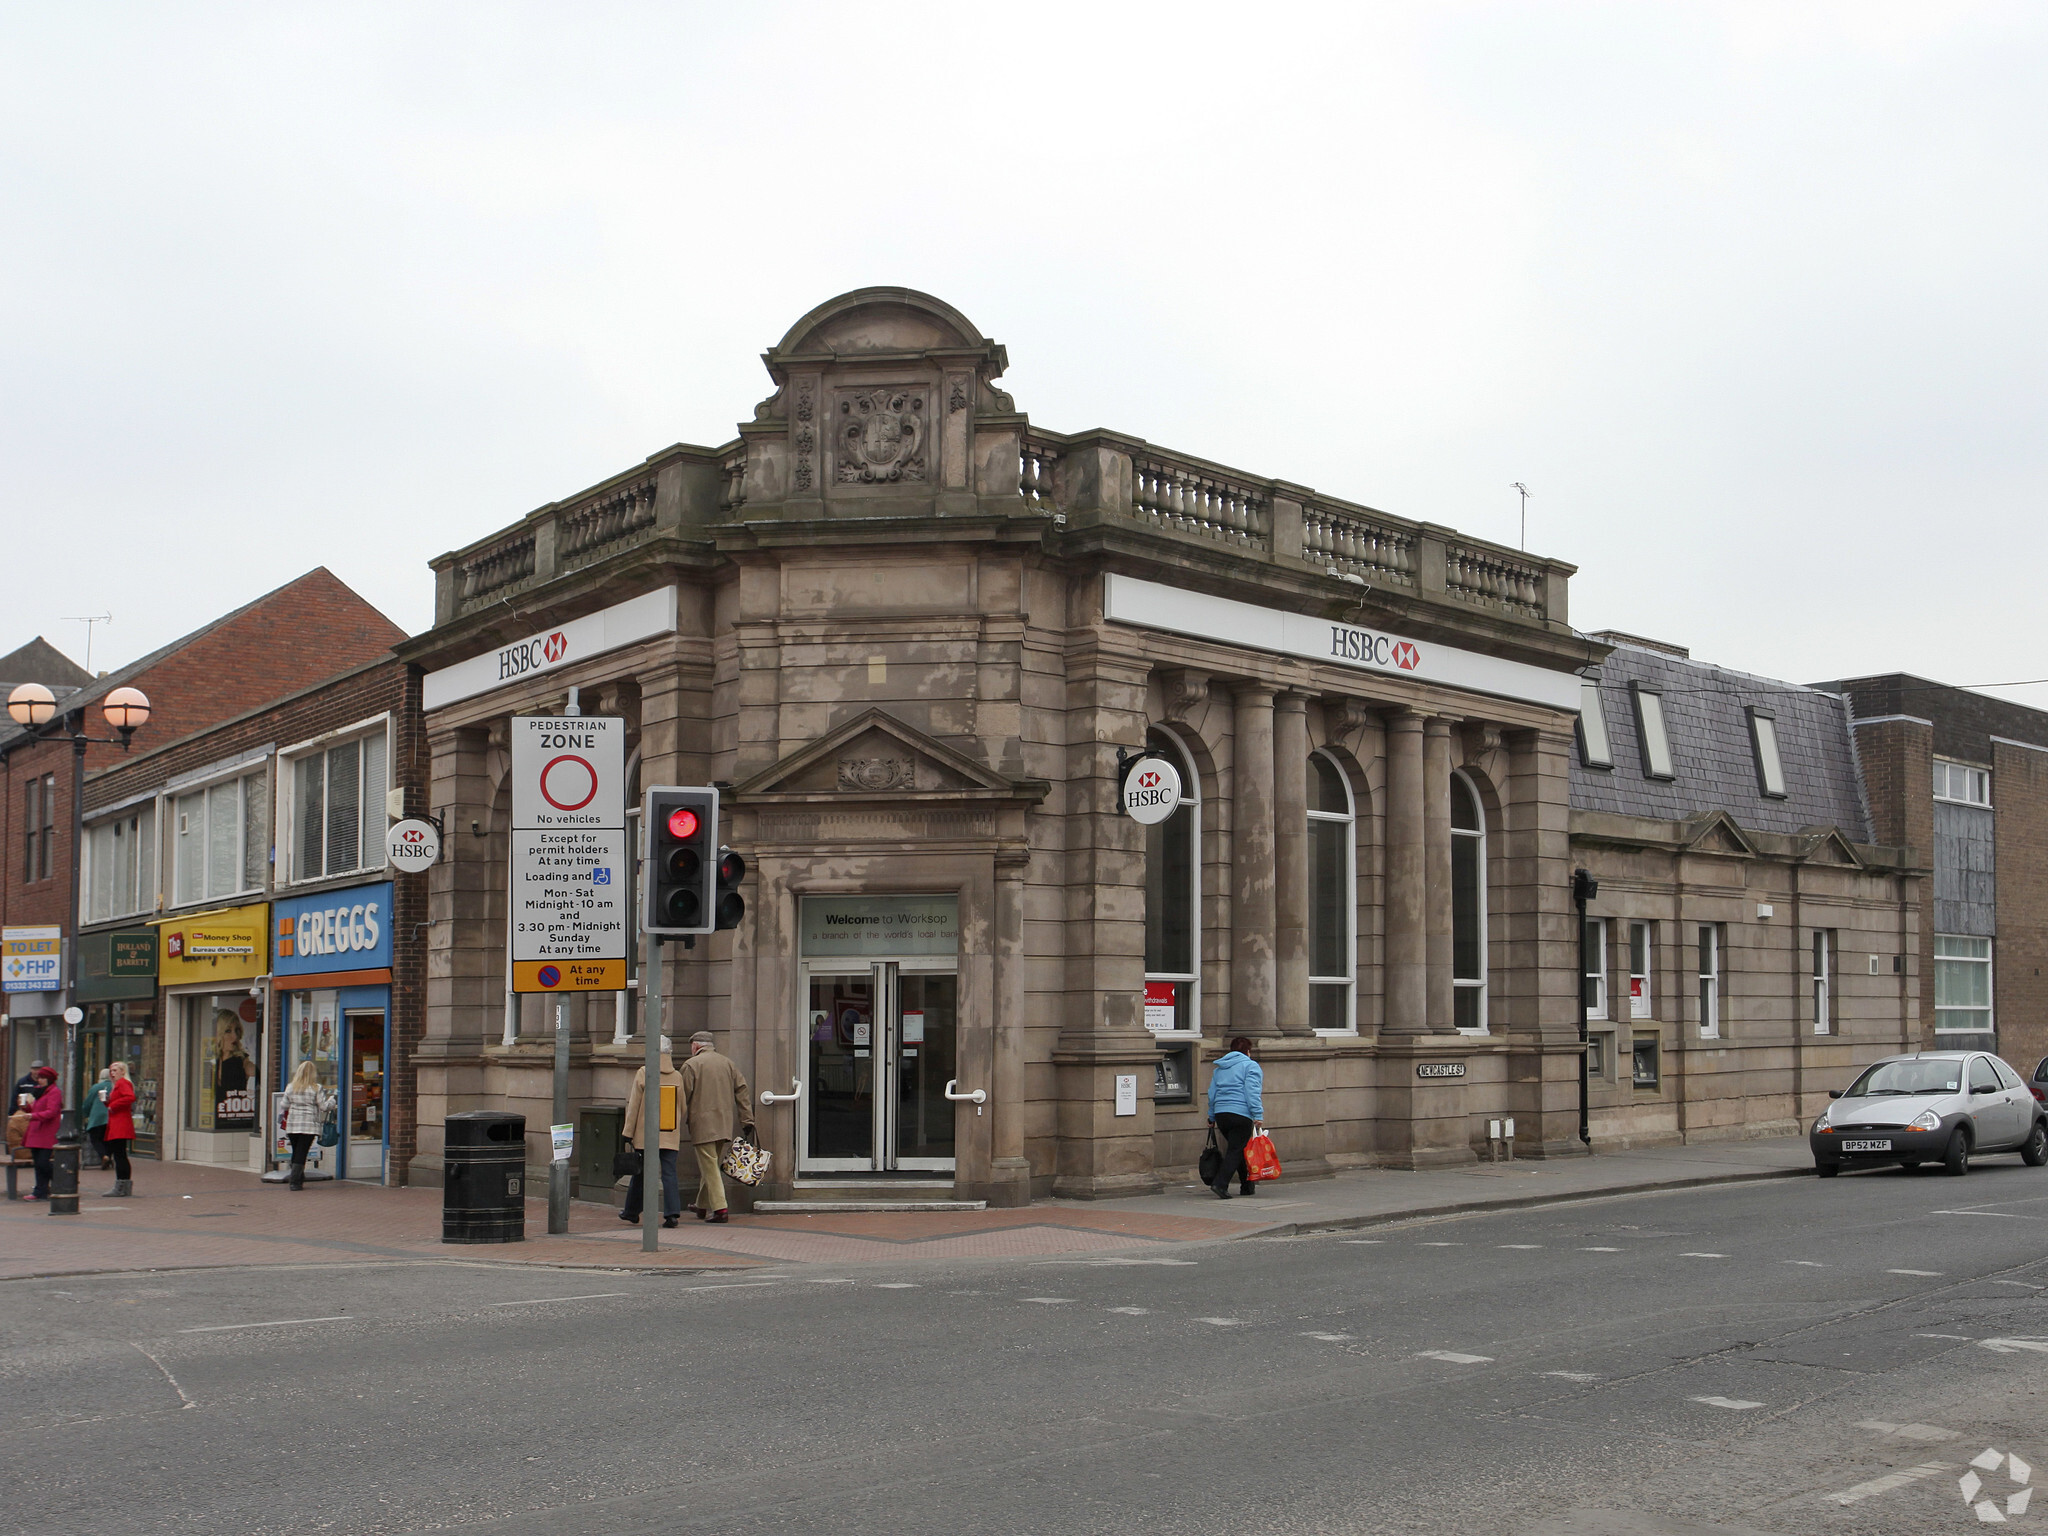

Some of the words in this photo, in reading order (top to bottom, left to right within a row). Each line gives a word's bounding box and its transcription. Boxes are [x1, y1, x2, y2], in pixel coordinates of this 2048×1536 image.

[1330, 626, 1389, 665] HSBC
[498, 638, 543, 681] HSBC
[530, 721, 607, 730] PEDESTRIAN
[540, 734, 596, 749] ZONE
[1128, 788, 1172, 808] HSBC
[537, 814, 553, 824] No
[556, 814, 601, 824] vehicles
[540, 834, 579, 845] Except
[581, 833, 597, 843] for
[391, 844, 435, 858] HSBC
[529, 845, 565, 856] permit
[568, 845, 609, 854] holders
[538, 856, 551, 866] At
[554, 858, 573, 867] any
[576, 856, 601, 865] time
[525, 872, 569, 883] Loading
[571, 871, 592, 881] and
[544, 888, 568, 898] Mon
[575, 888, 595, 897] Sat
[525, 900, 575, 911] Midnight
[581, 899, 594, 908] 10
[597, 901, 613, 909] am
[559, 911, 580, 920] and
[825, 914, 880, 925] Welcome
[882, 914, 893, 924] to
[898, 913, 948, 925] Worksop
[297, 902, 379, 957] GREGGS
[518, 922, 545, 932] 3.30
[548, 924, 565, 933] pm
[572, 921, 621, 932] Midnight
[203, 934, 230, 942] Money
[549, 933, 590, 943] Sunday
[812, 932, 818, 940] a
[821, 930, 849, 940] branch
[852, 931, 862, 940] of
[866, 930, 880, 939] the
[884, 930, 913, 939] world's
[917, 930, 936, 939] local
[10, 942, 27, 953] TO
[29, 941, 53, 952] LET
[117, 942, 150, 951] HOLLAND
[168, 937, 181, 954] The
[539, 945, 552, 954] At
[554, 946, 574, 955] any
[577, 944, 601, 953] time
[26, 960, 56, 974] FHP
[116, 958, 149, 967] BARRETT
[569, 965, 583, 974] At
[586, 966, 606, 975] any
[575, 976, 600, 986] time
[1421, 1065, 1455, 1075] NEWCASTLE
